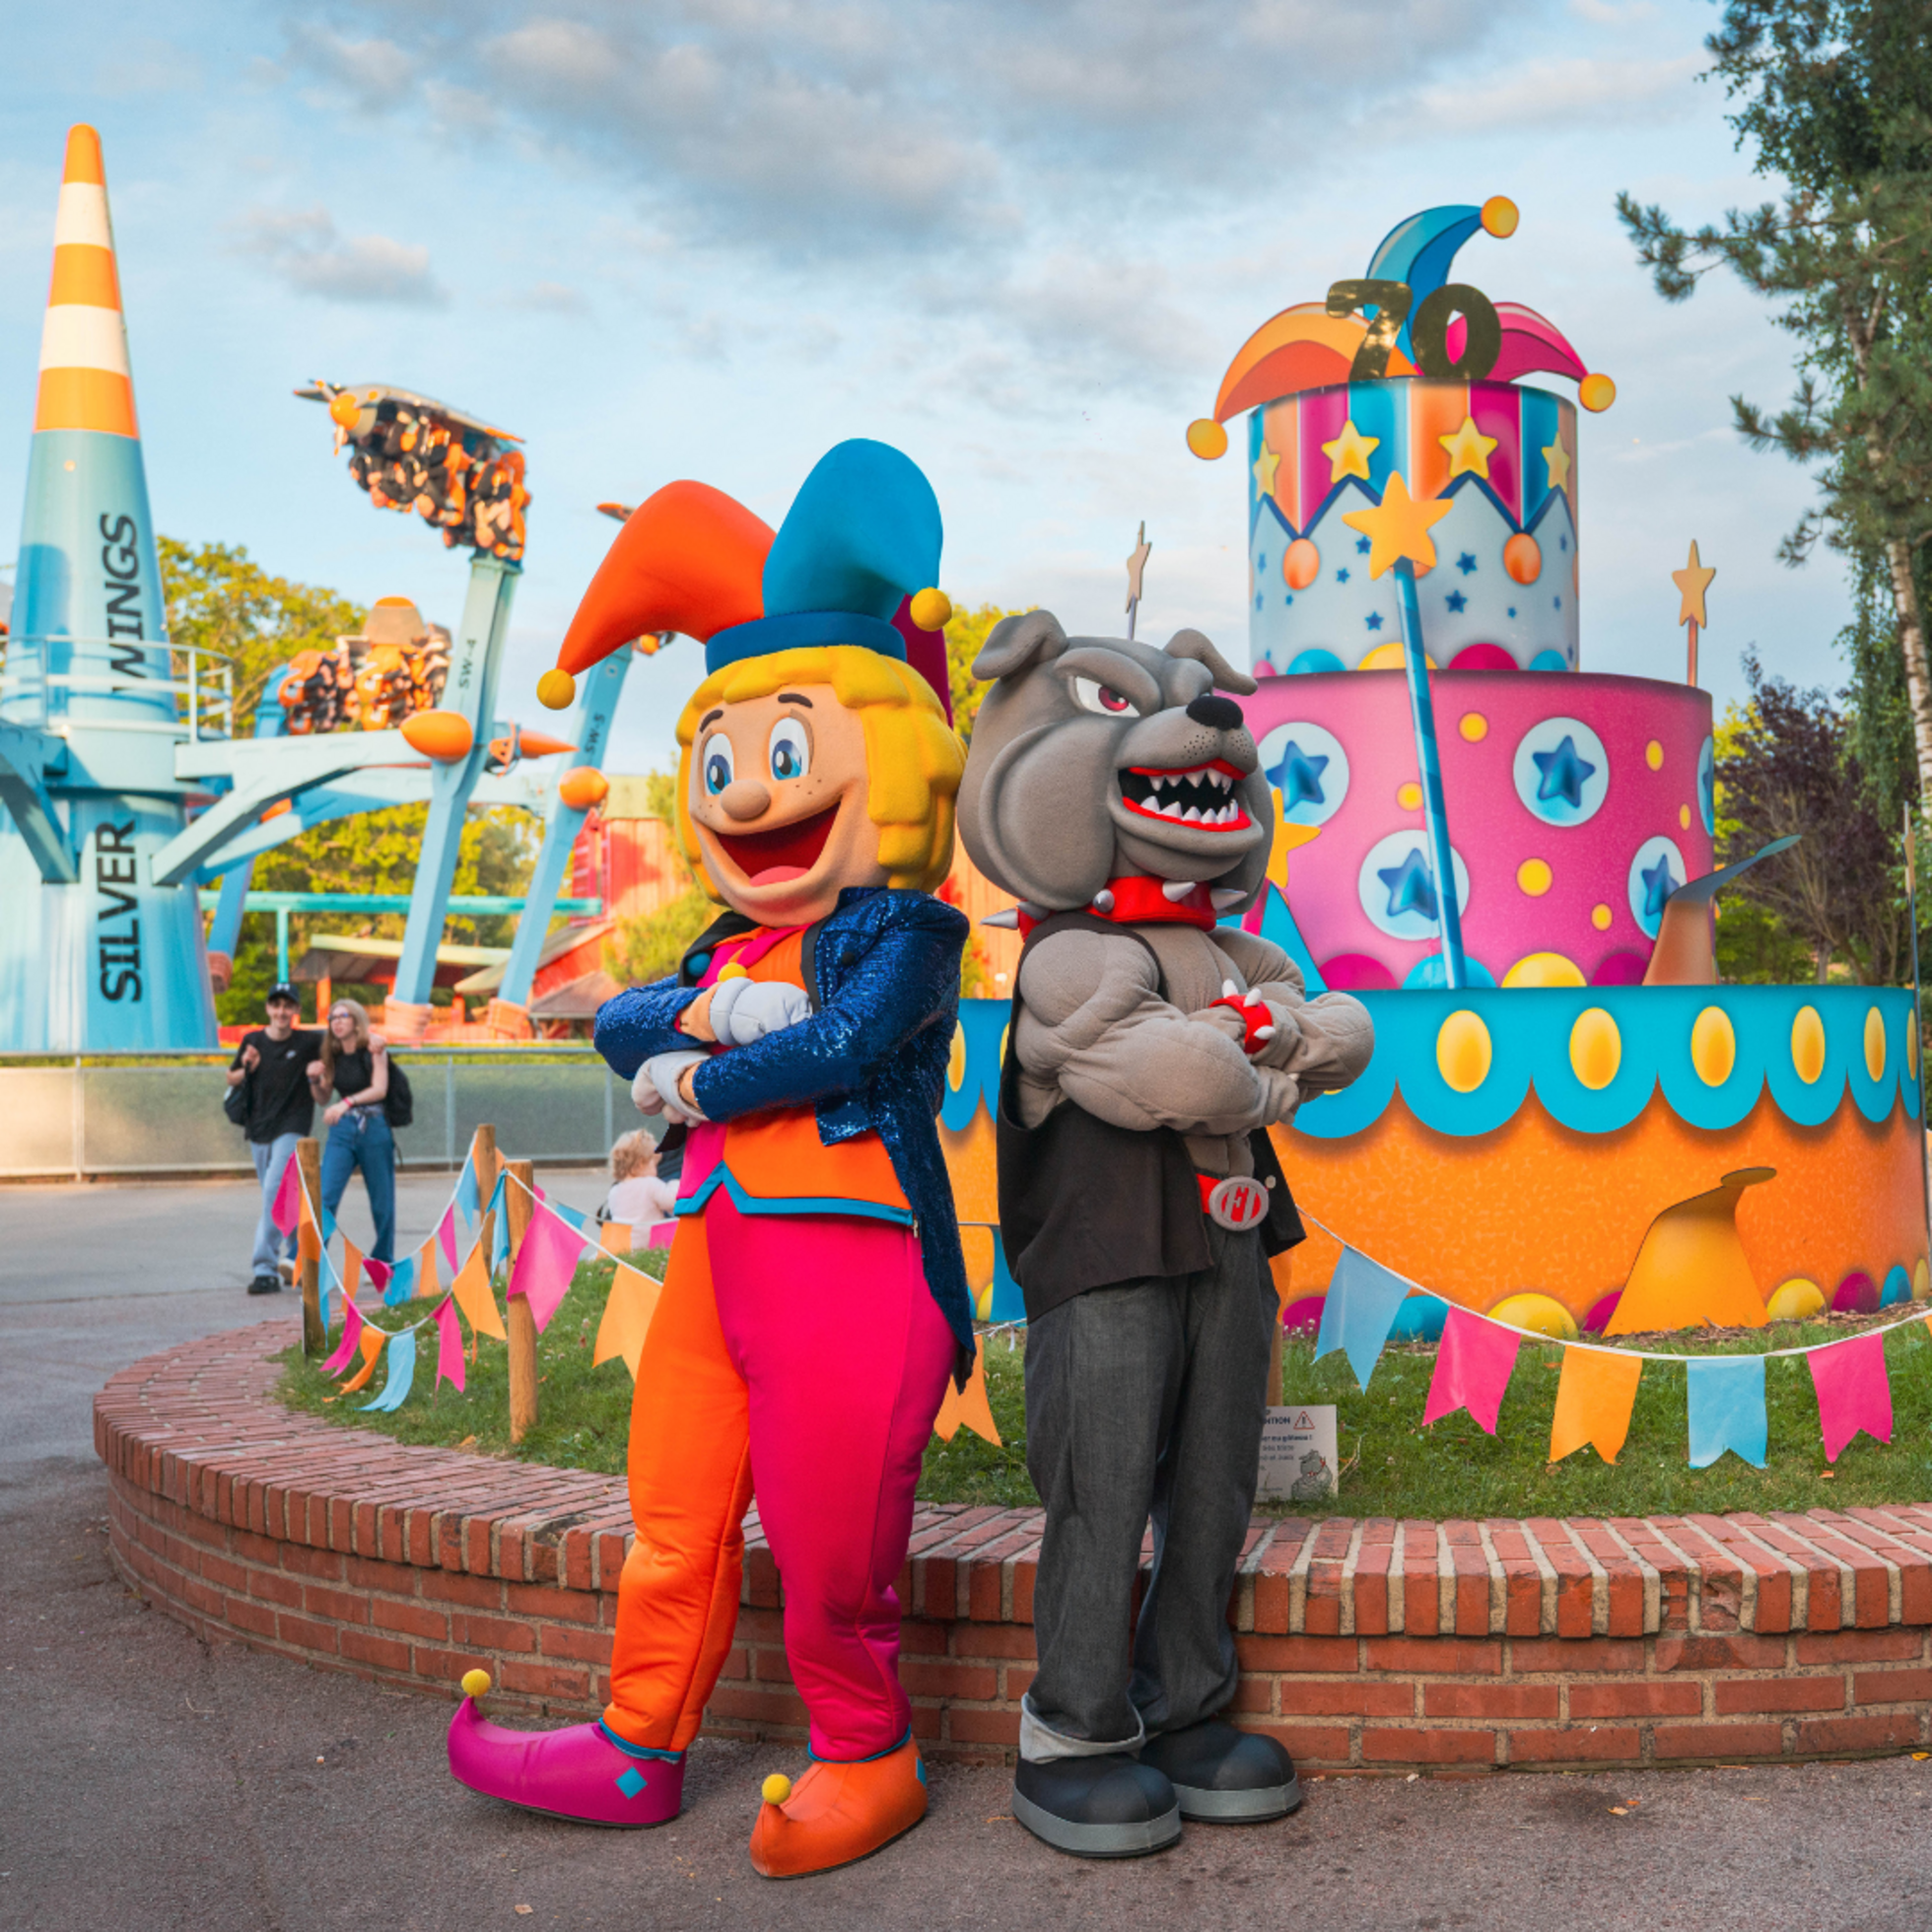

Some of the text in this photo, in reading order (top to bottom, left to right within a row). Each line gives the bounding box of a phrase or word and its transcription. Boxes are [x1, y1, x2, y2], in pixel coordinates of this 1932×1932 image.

[1326, 279, 1501, 380] 70
[96, 514, 147, 1002] SILVER WINGS
